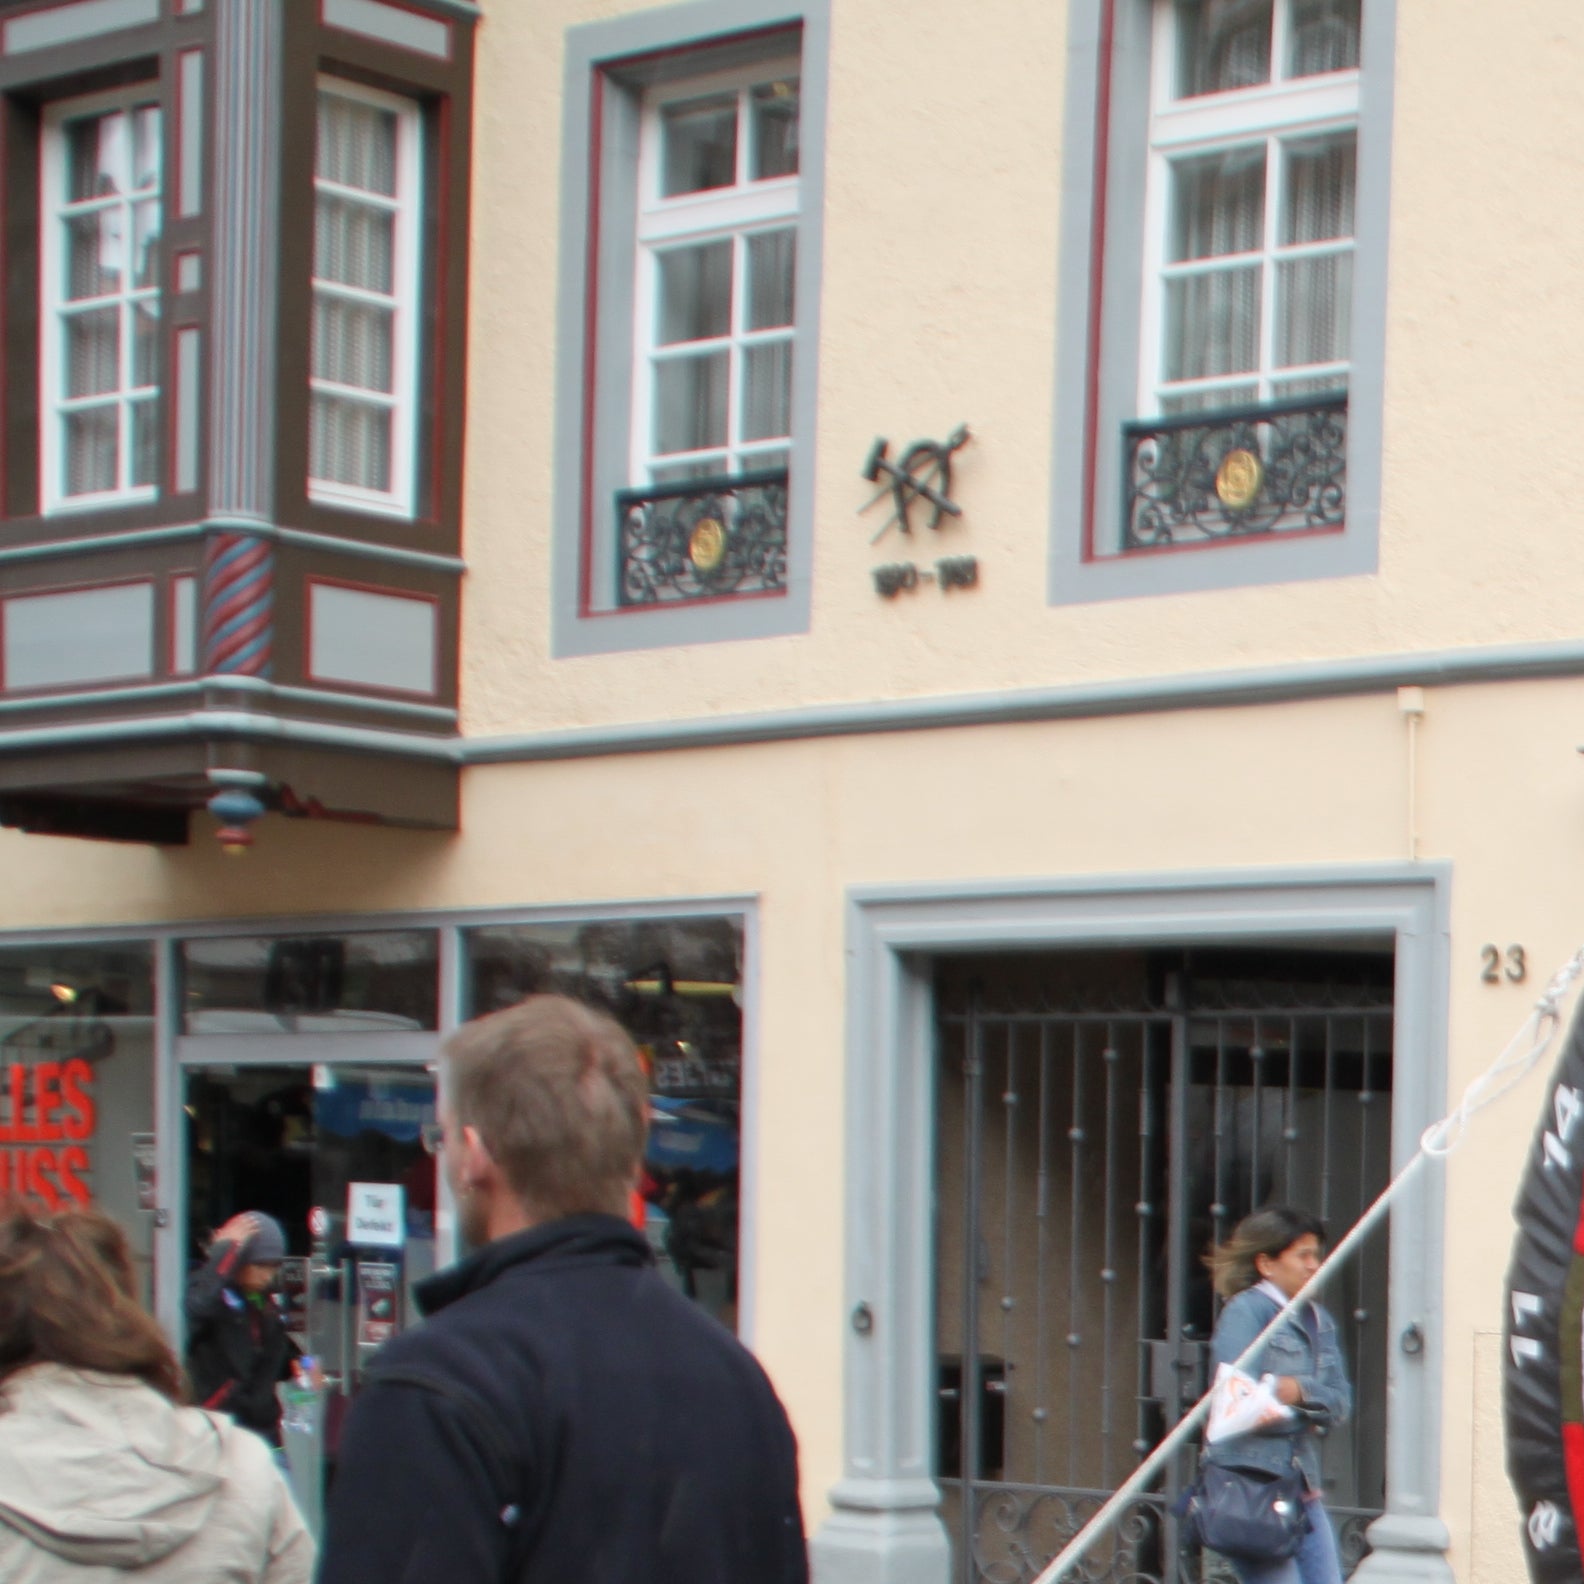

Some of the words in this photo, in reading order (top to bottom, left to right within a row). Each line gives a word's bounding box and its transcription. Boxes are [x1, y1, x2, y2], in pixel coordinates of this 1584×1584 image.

[1481, 943, 1527, 985] 23
[0, 1057, 96, 1142] LES
[1543, 1082, 1583, 1173] 14
[1509, 1290, 1543, 1370] 11
[1527, 1500, 1561, 1550] 8
